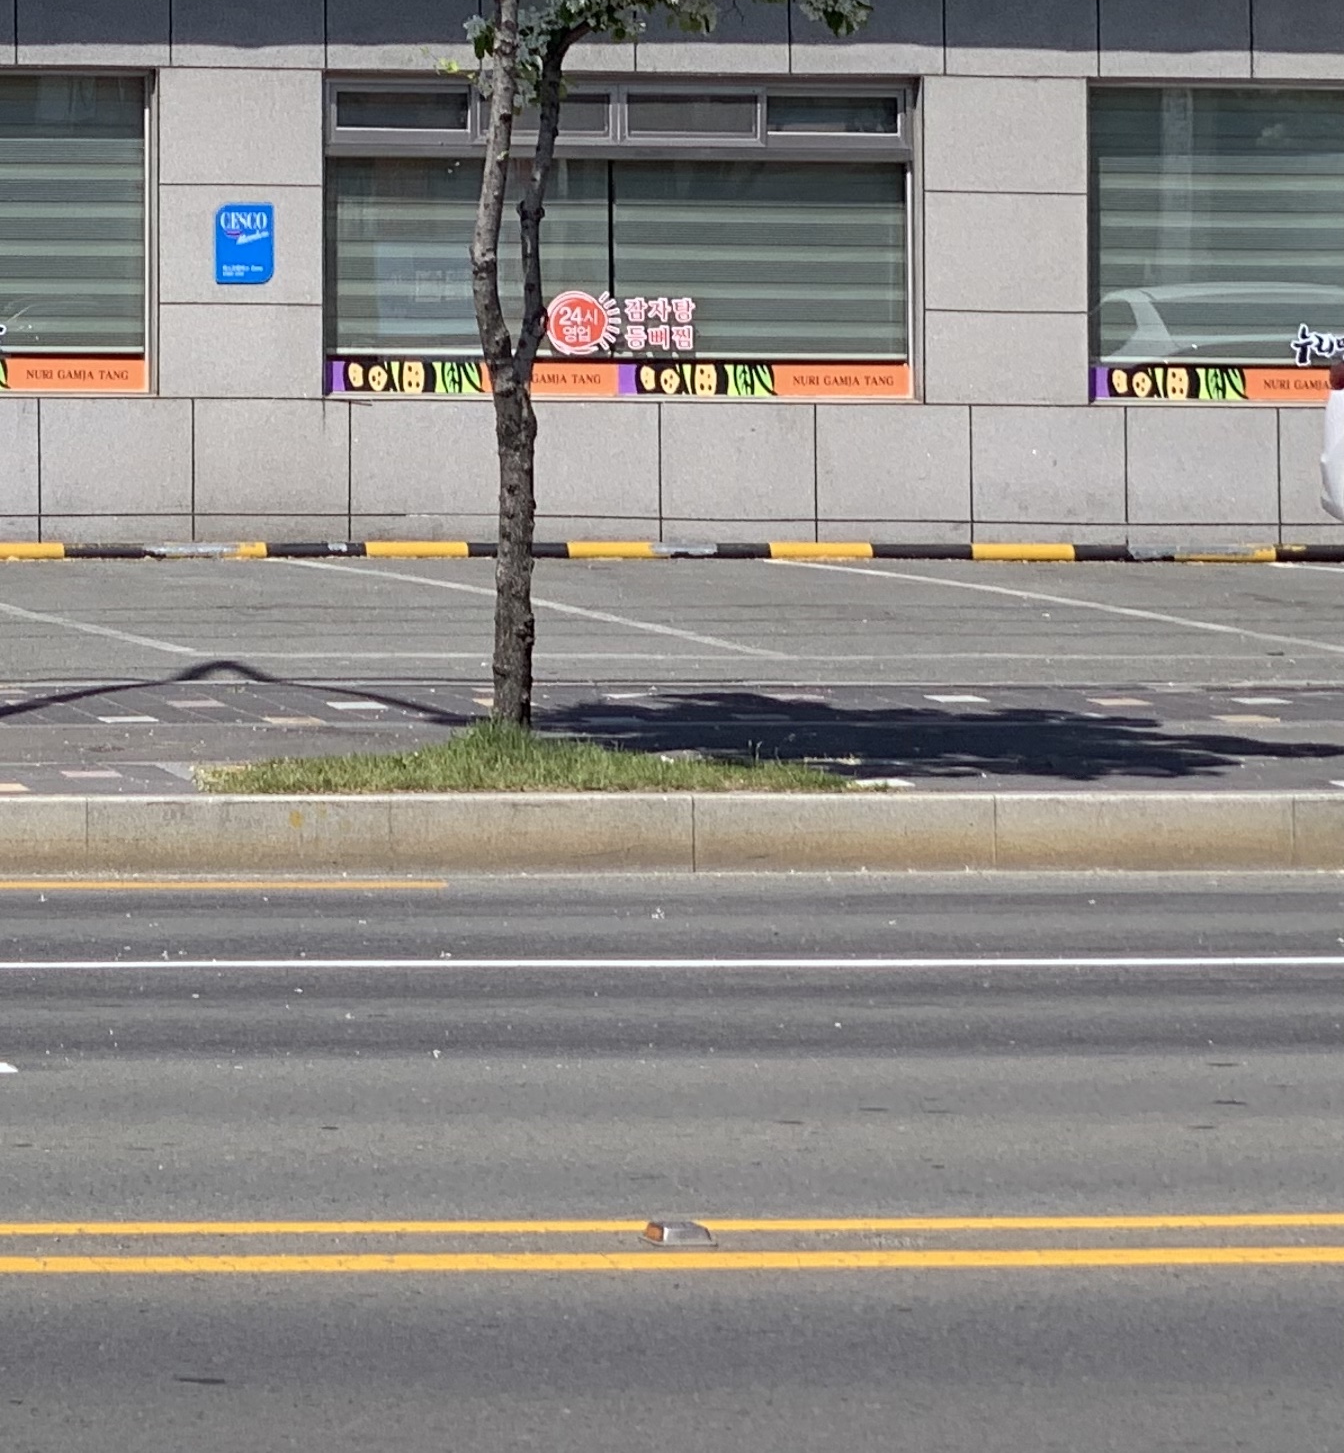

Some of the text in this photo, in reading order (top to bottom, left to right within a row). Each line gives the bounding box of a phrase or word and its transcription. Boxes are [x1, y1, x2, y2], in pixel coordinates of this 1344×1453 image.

[220, 211, 268, 229] CESCO
[558, 306, 599, 325] 24시
[624, 297, 696, 323] 감자탕
[562, 326, 592, 343] 영업
[26, 369, 129, 382] NURI GAMJA TANG
[571, 374, 601, 384] TANG
[793, 375, 894, 387] NURI GAMJA TANG
[1263, 379, 1290, 389] NURI
